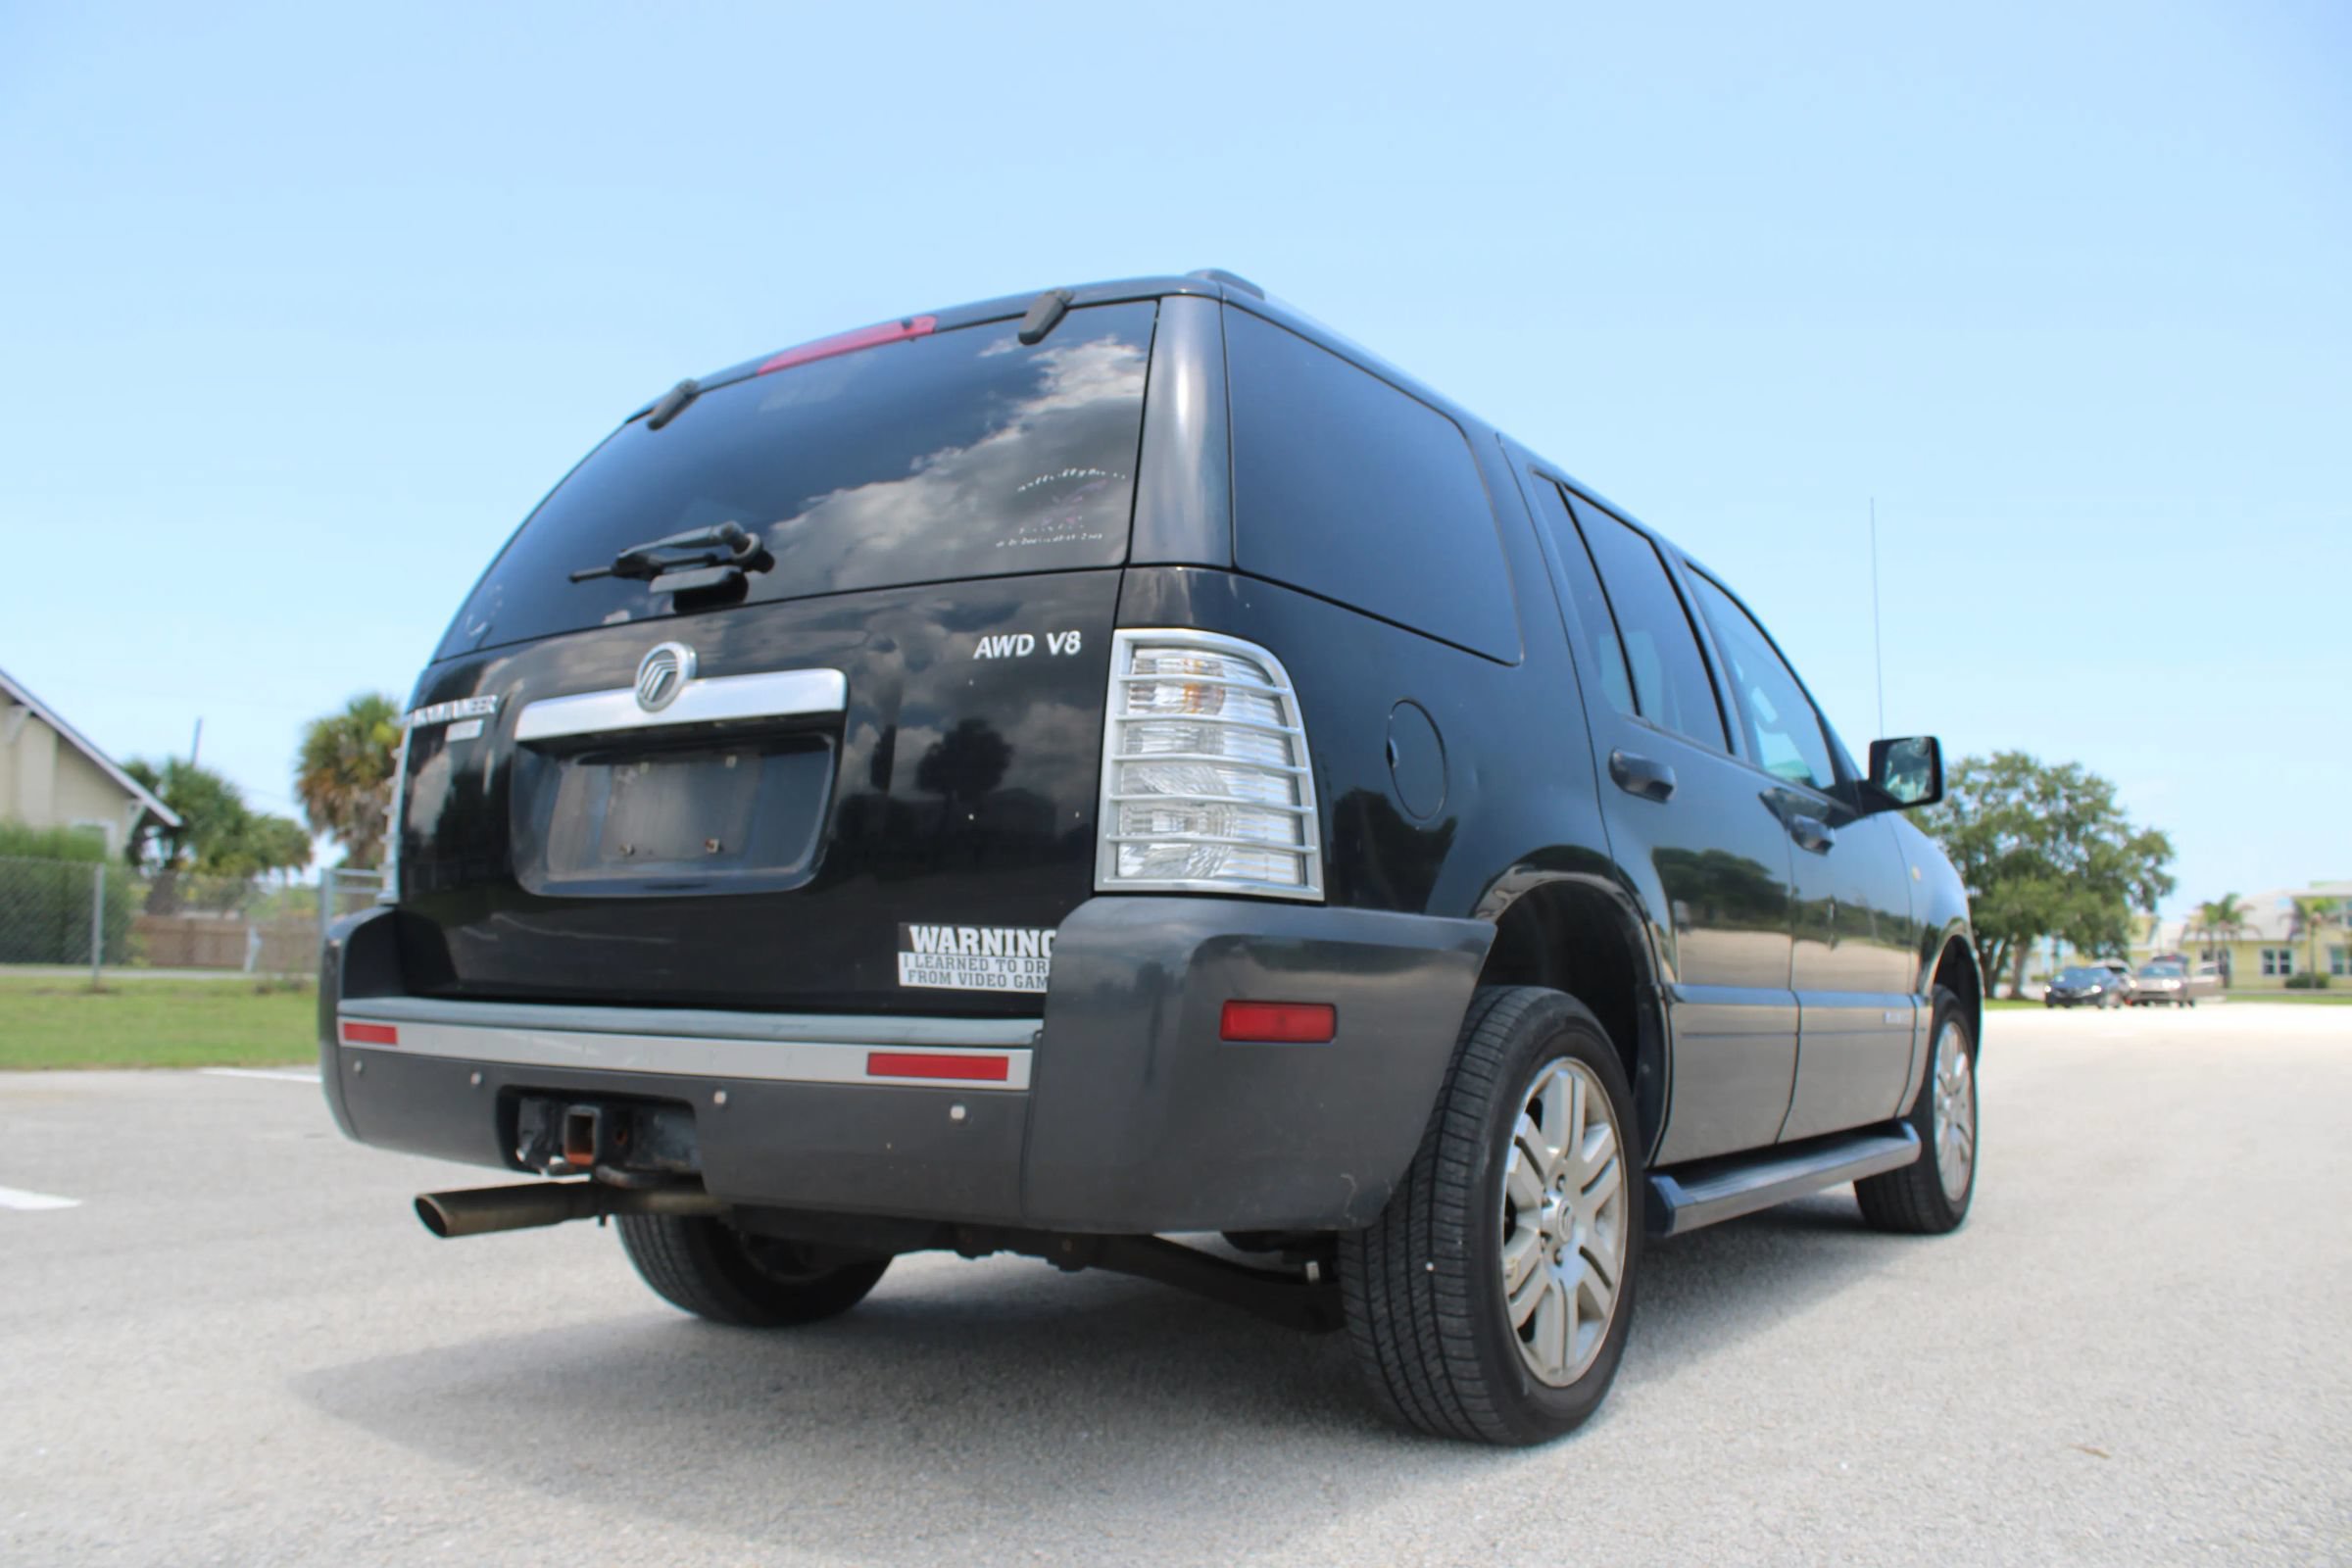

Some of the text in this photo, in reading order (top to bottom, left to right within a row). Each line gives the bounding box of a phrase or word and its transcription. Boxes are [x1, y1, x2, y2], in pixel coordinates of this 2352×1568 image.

[973, 630, 1081, 659] AWD V8
[915, 956, 989, 971] LEARNED
[996, 959, 1017, 973] TO
[907, 970, 952, 985] FROM
[958, 973, 1006, 987] VIDEO
